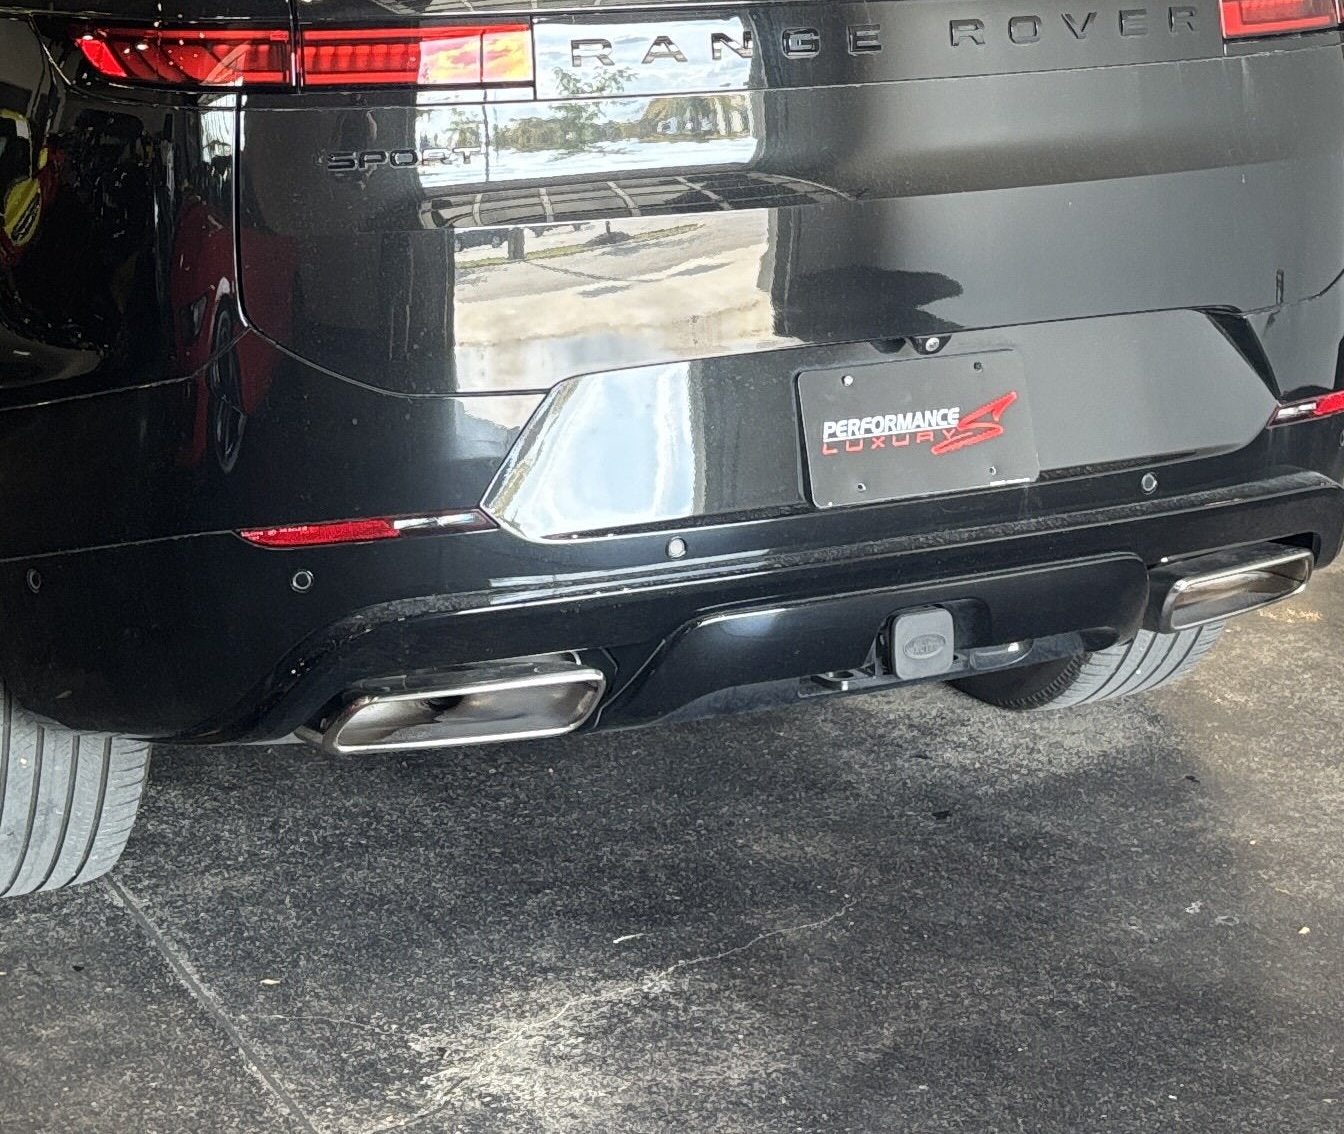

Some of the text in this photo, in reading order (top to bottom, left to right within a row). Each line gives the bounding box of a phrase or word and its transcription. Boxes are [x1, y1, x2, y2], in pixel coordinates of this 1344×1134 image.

[571, 5, 1198, 68] RANGE ROVER
[327, 146, 482, 172] SPORT
[823, 407, 960, 440] PERFORMANCE
[822, 428, 957, 456] LUXURY
